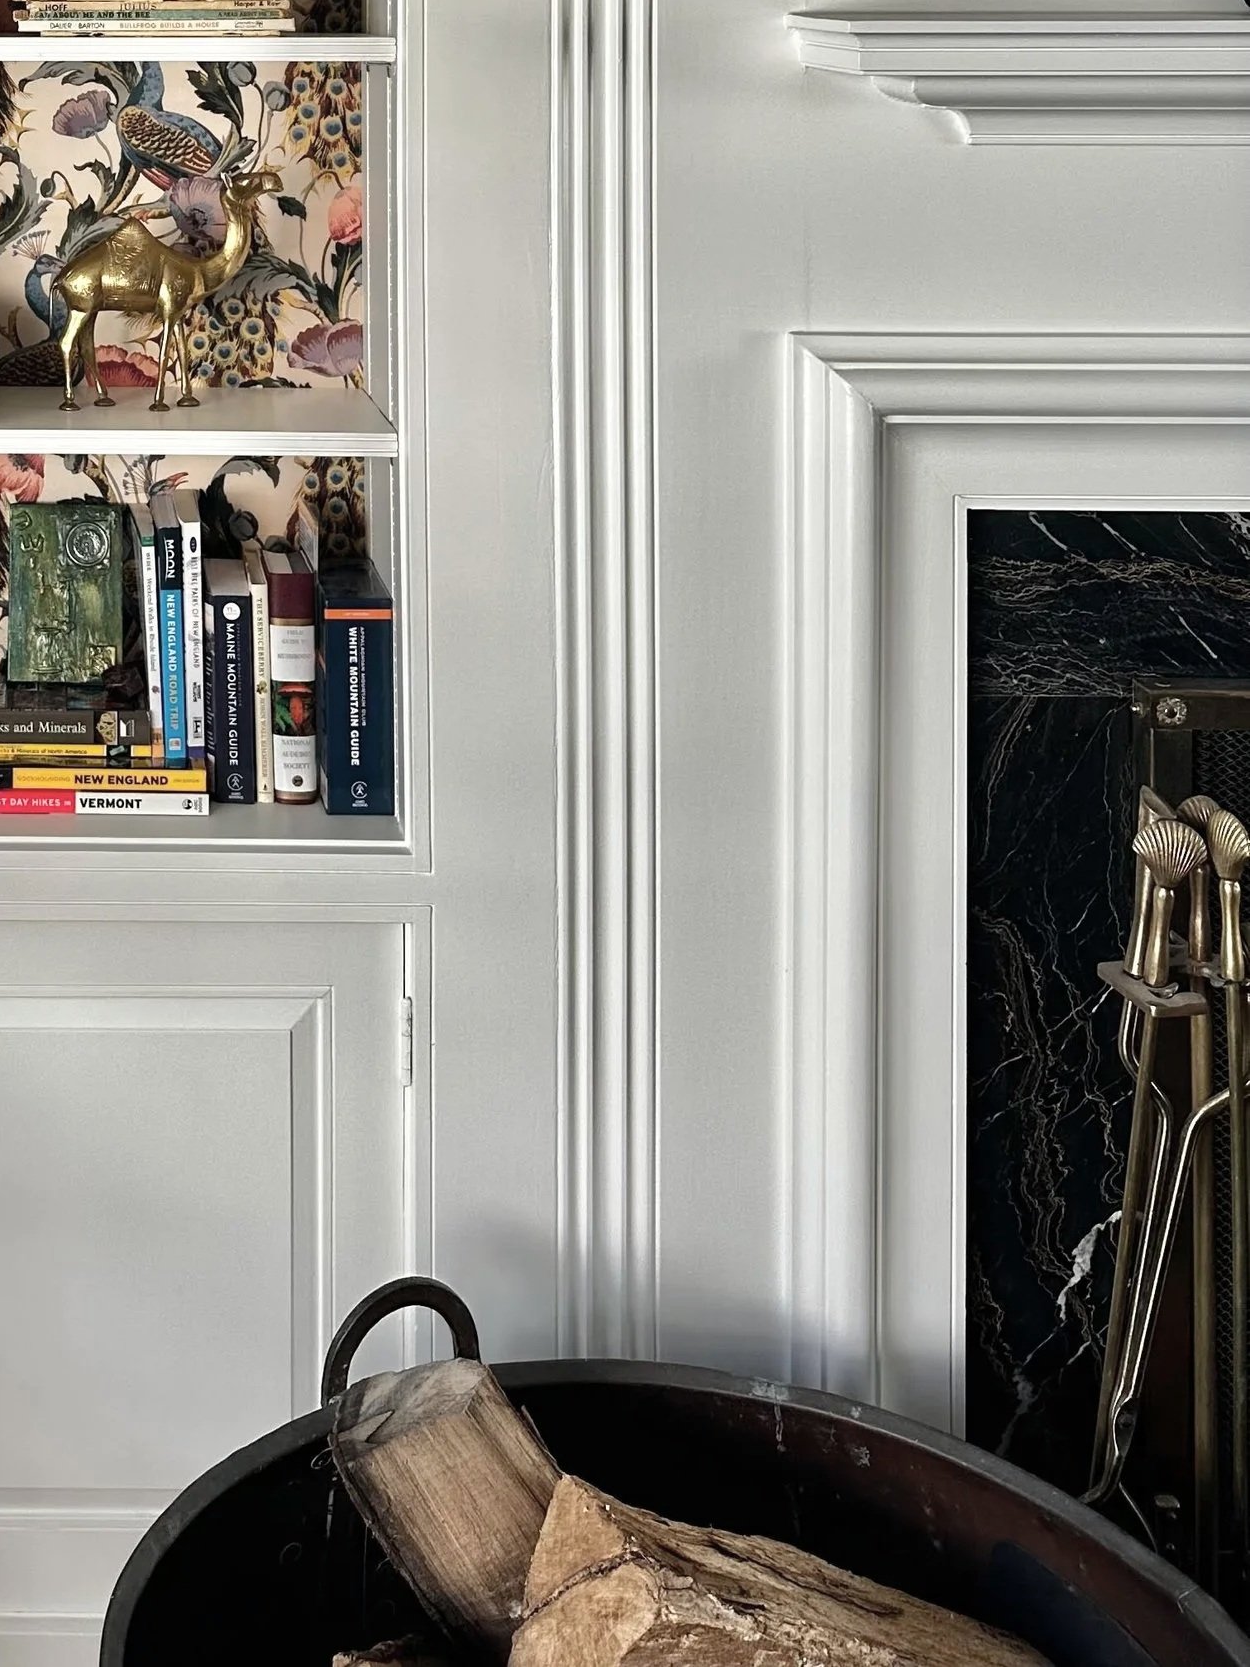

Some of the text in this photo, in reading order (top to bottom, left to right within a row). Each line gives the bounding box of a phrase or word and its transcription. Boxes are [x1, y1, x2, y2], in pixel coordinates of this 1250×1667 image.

[45, 4, 68, 12] HOFF
[234, 0, 256, 8] Harper
[191, 588, 199, 606] PATHS
[192, 608, 199, 617] OF
[166, 539, 179, 730] MOON NEW ENGLAND ROAD TRIP
[257, 617, 265, 677] SERVICEBERRY
[226, 623, 238, 765] MAINE MOUNTAIN GUIDE
[349, 627, 360, 766] WHITE MOUNTAIN GUIDE
[13, 722, 34, 733] and
[38, 721, 87, 733] Minerals
[74, 775, 104, 784] NEW
[108, 775, 168, 785] ENGLAND
[10, 798, 28, 806] DAY
[32, 798, 61, 806] HIKES
[80, 798, 142, 809] VERMONT
